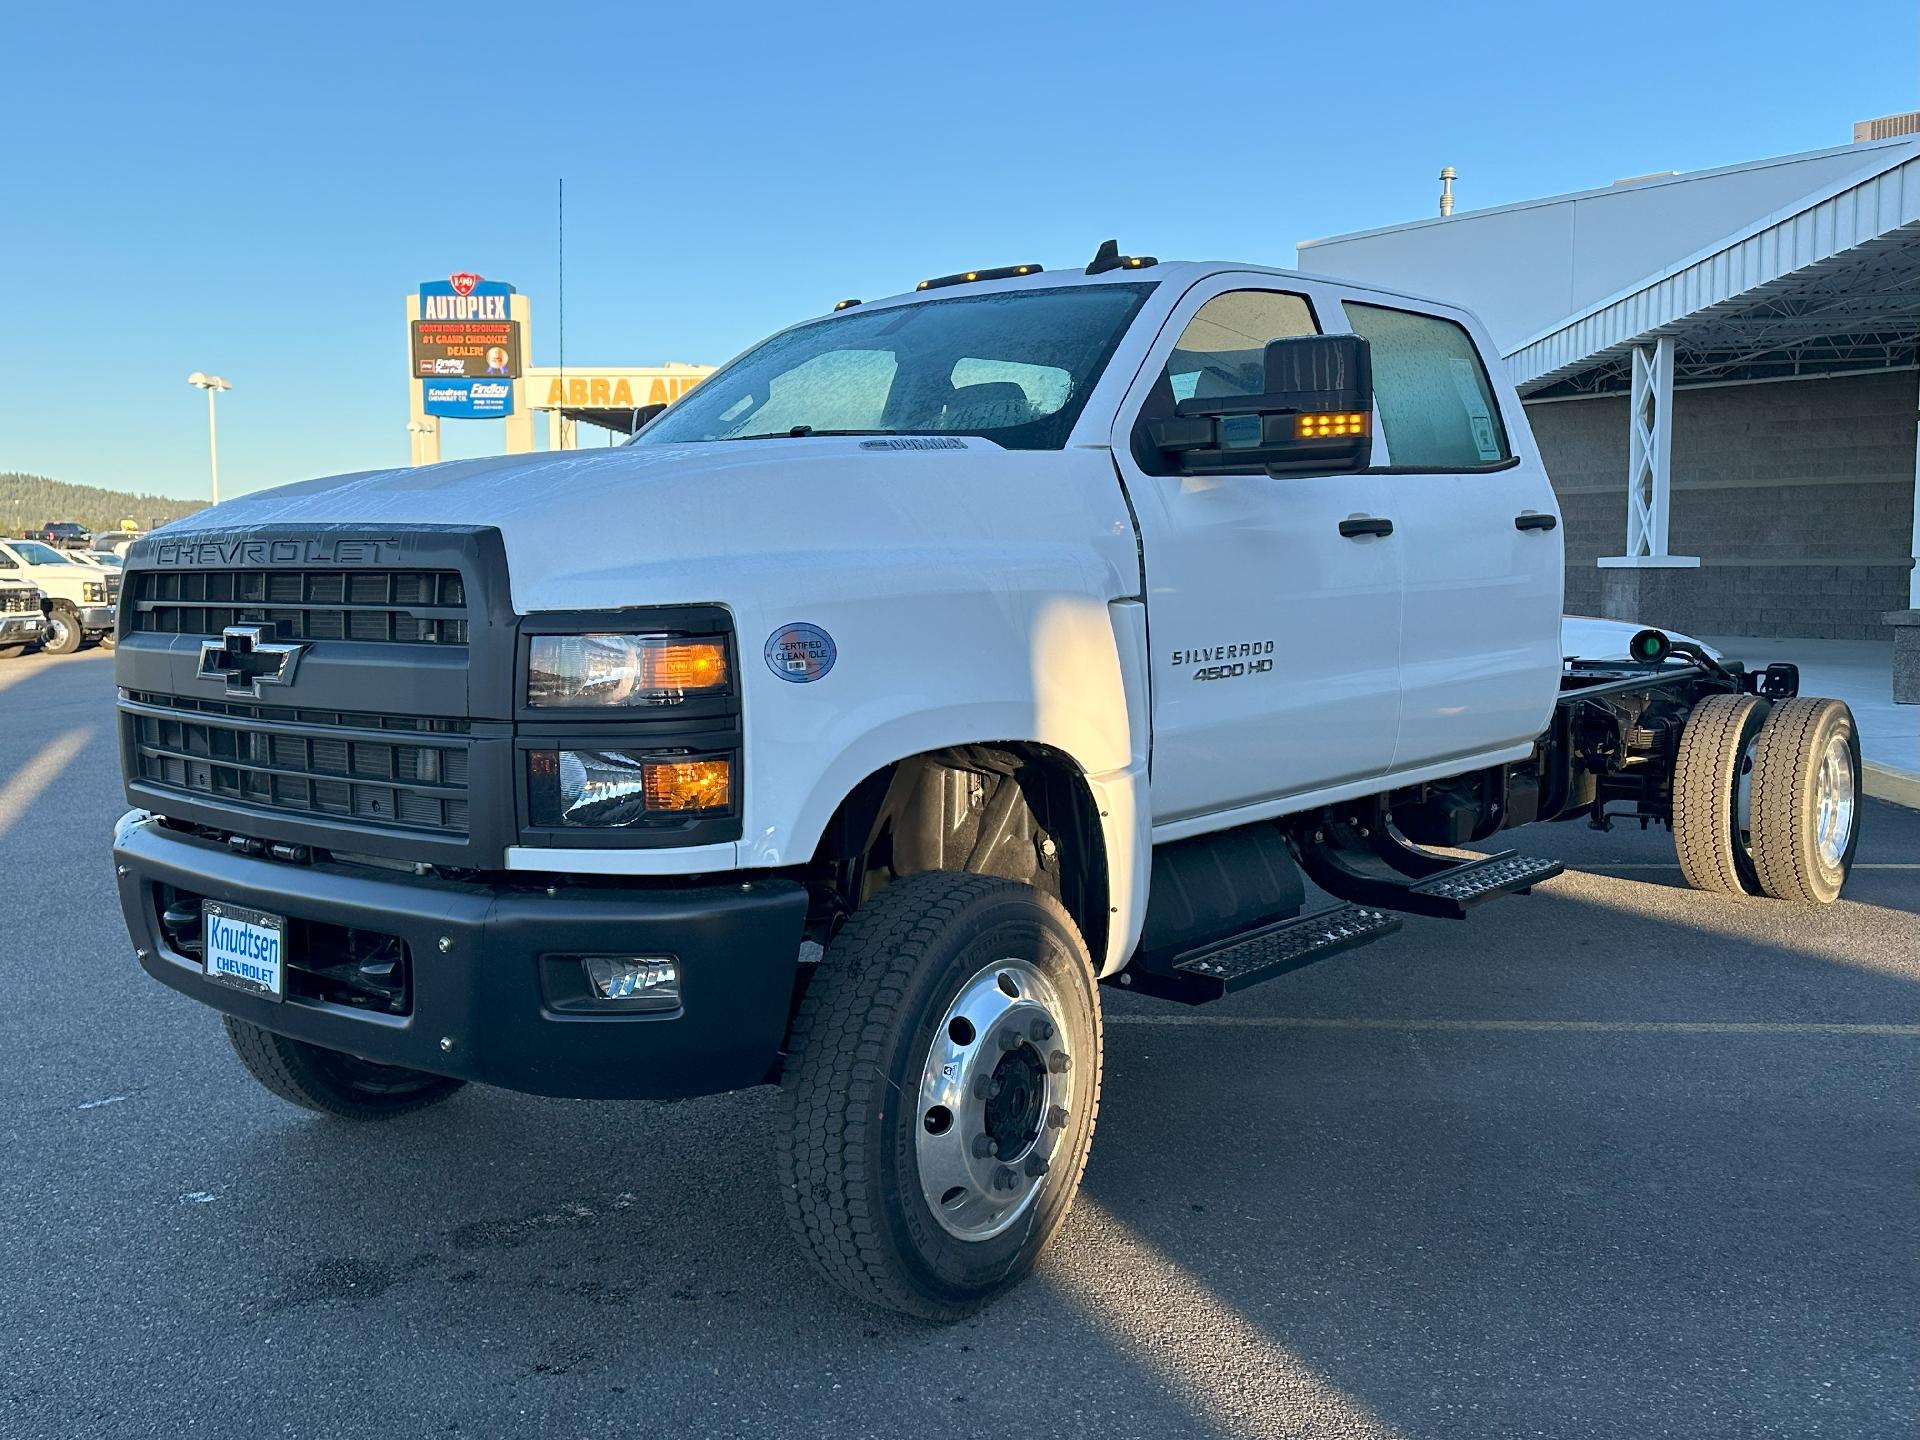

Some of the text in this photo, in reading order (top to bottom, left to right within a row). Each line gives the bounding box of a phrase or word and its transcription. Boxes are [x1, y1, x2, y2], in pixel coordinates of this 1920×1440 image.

[426, 296, 505, 320] AUTOPLEX
[435, 335, 464, 344] GRAND
[465, 335, 507, 344] CHEROKEE
[447, 346, 484, 357] DEALER!
[428, 388, 467, 396] Knudtsen
[472, 384, 508, 395] Findlay
[547, 378, 634, 405] ABRA
[889, 437, 969, 451] DURAMAX
[156, 539, 400, 566] CHEVROLET
[775, 649, 828, 661] CLEAN IDLE
[778, 640, 822, 651] CERTIFIED
[1171, 640, 1275, 666] SILVERADO
[1192, 658, 1273, 682] 4500 HD
[211, 916, 278, 964] Knudtsen
[216, 956, 274, 984] CHEVROLET
